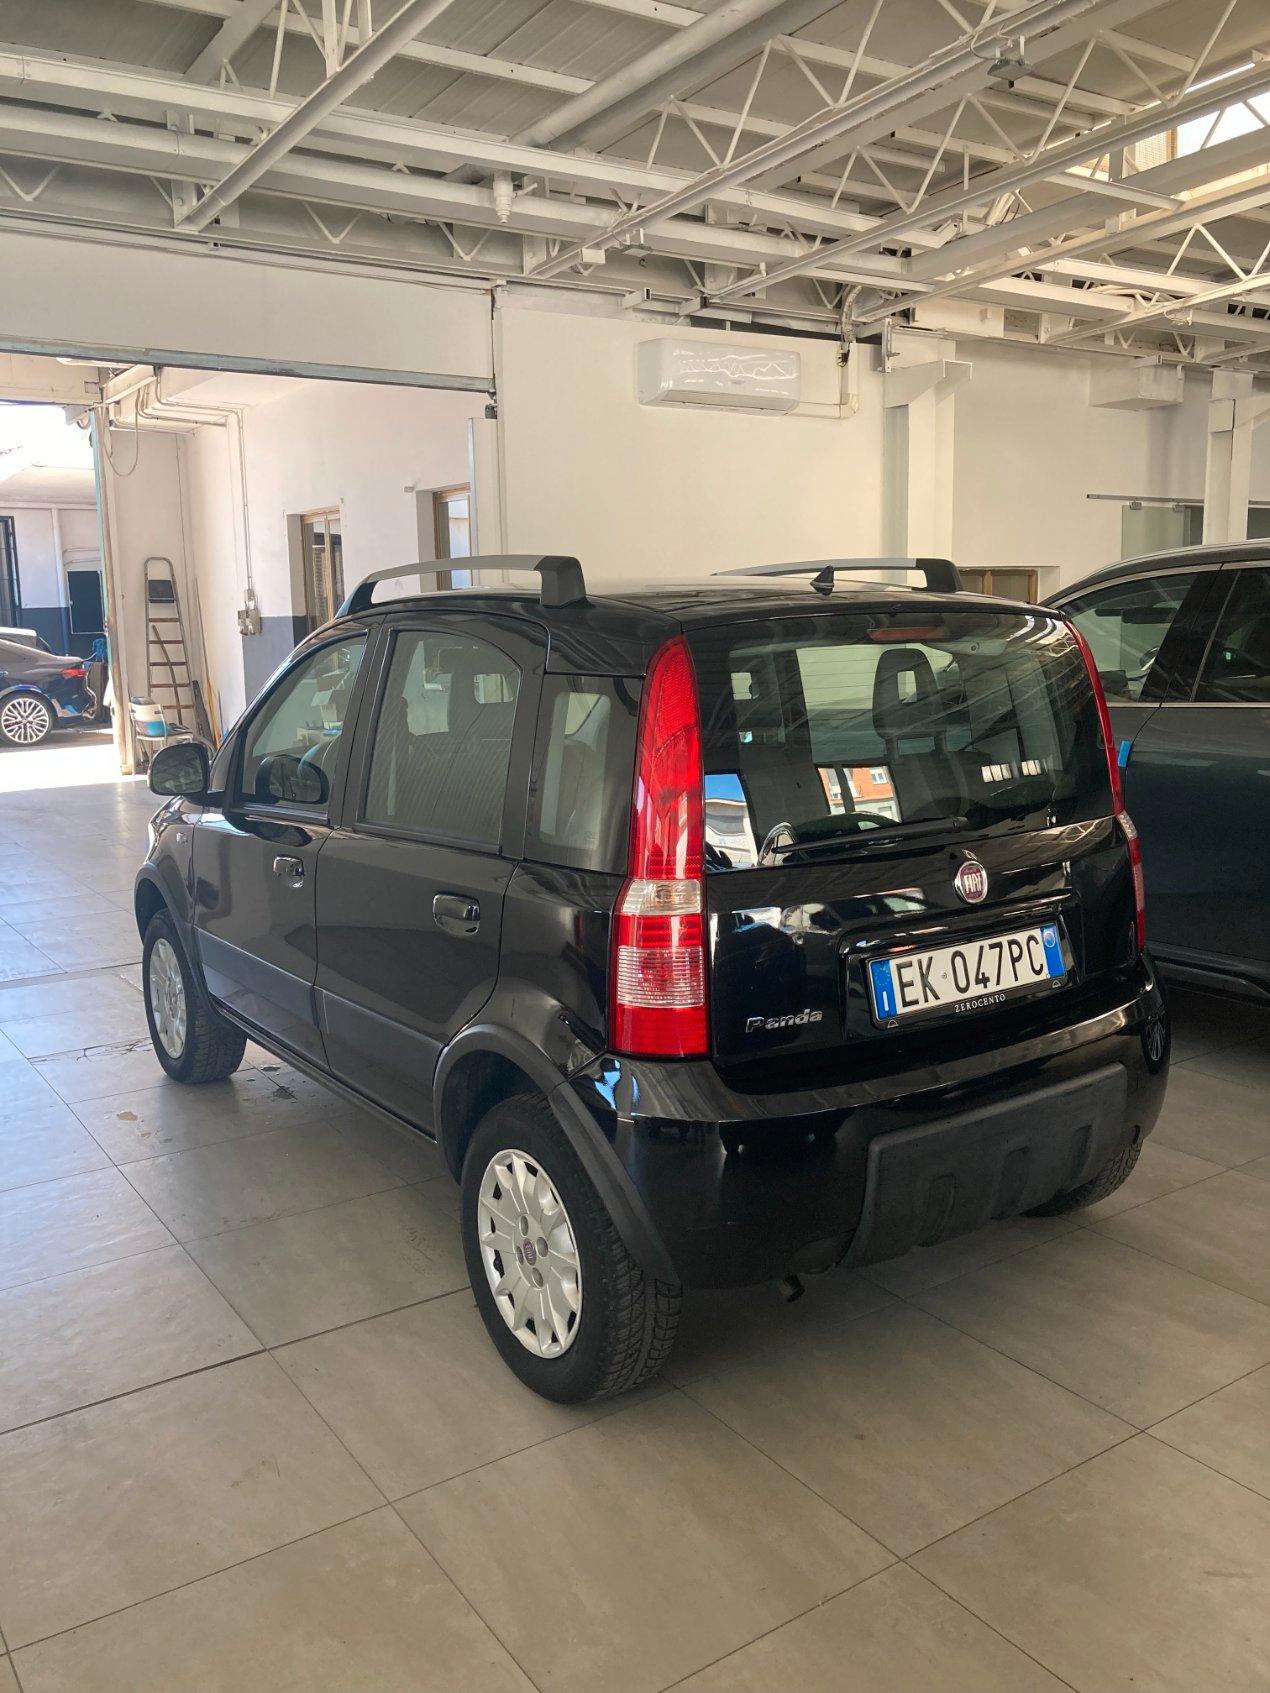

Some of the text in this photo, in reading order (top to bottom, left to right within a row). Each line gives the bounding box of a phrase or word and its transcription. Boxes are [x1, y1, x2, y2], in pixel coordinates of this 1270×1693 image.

[963, 872, 982, 894] FIAT
[895, 956, 941, 1008] EK
[950, 933, 1044, 994] 047PC
[954, 993, 1006, 1013] ZEROCENTO
[745, 1008, 823, 1033] Panda
